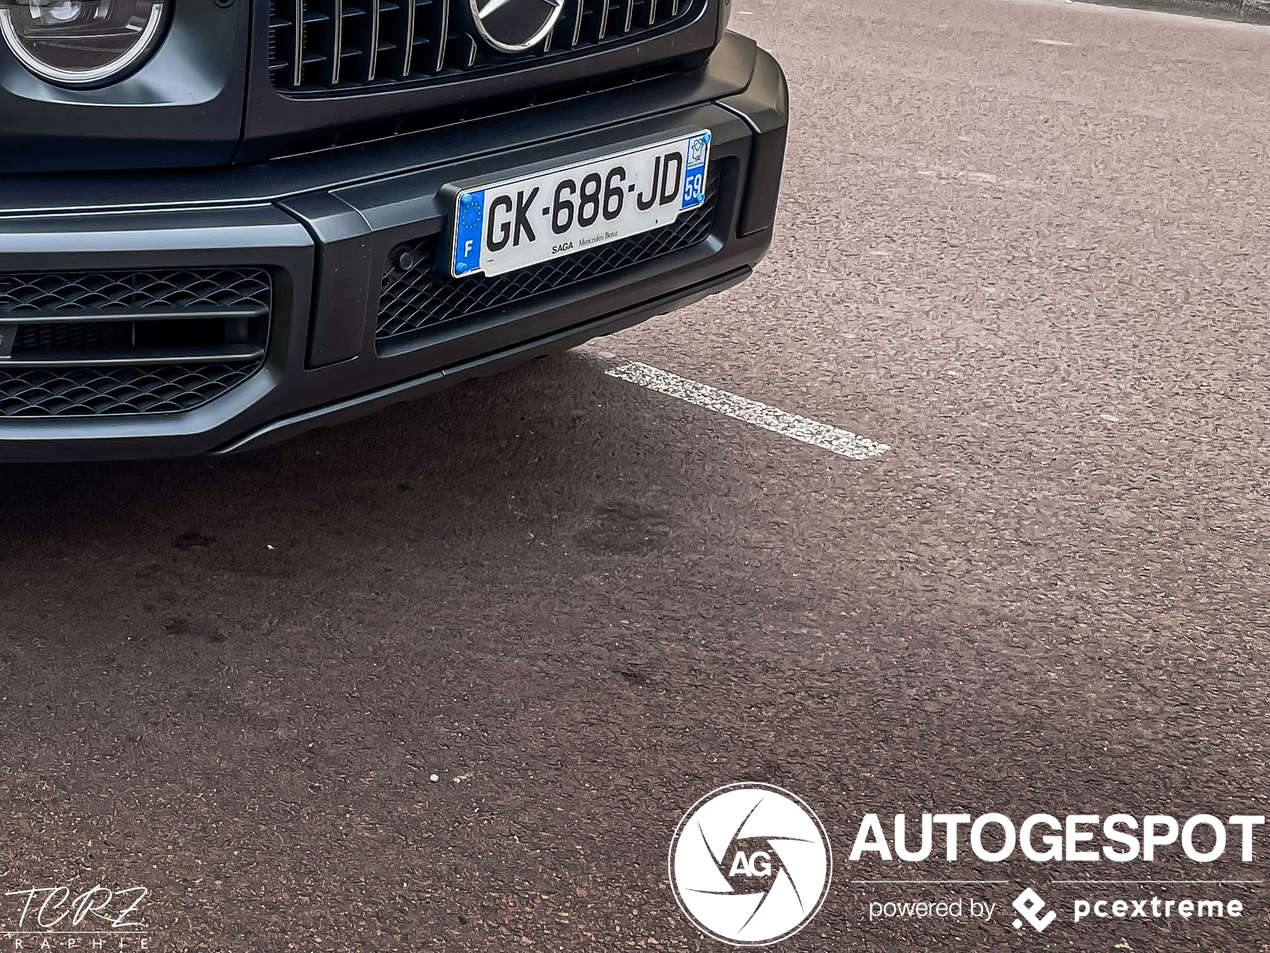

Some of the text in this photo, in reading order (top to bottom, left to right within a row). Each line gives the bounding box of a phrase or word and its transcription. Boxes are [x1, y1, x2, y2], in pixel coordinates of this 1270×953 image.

[463, 151, 703, 258] F GK-686-JD 59
[551, 241, 574, 254] SAGA
